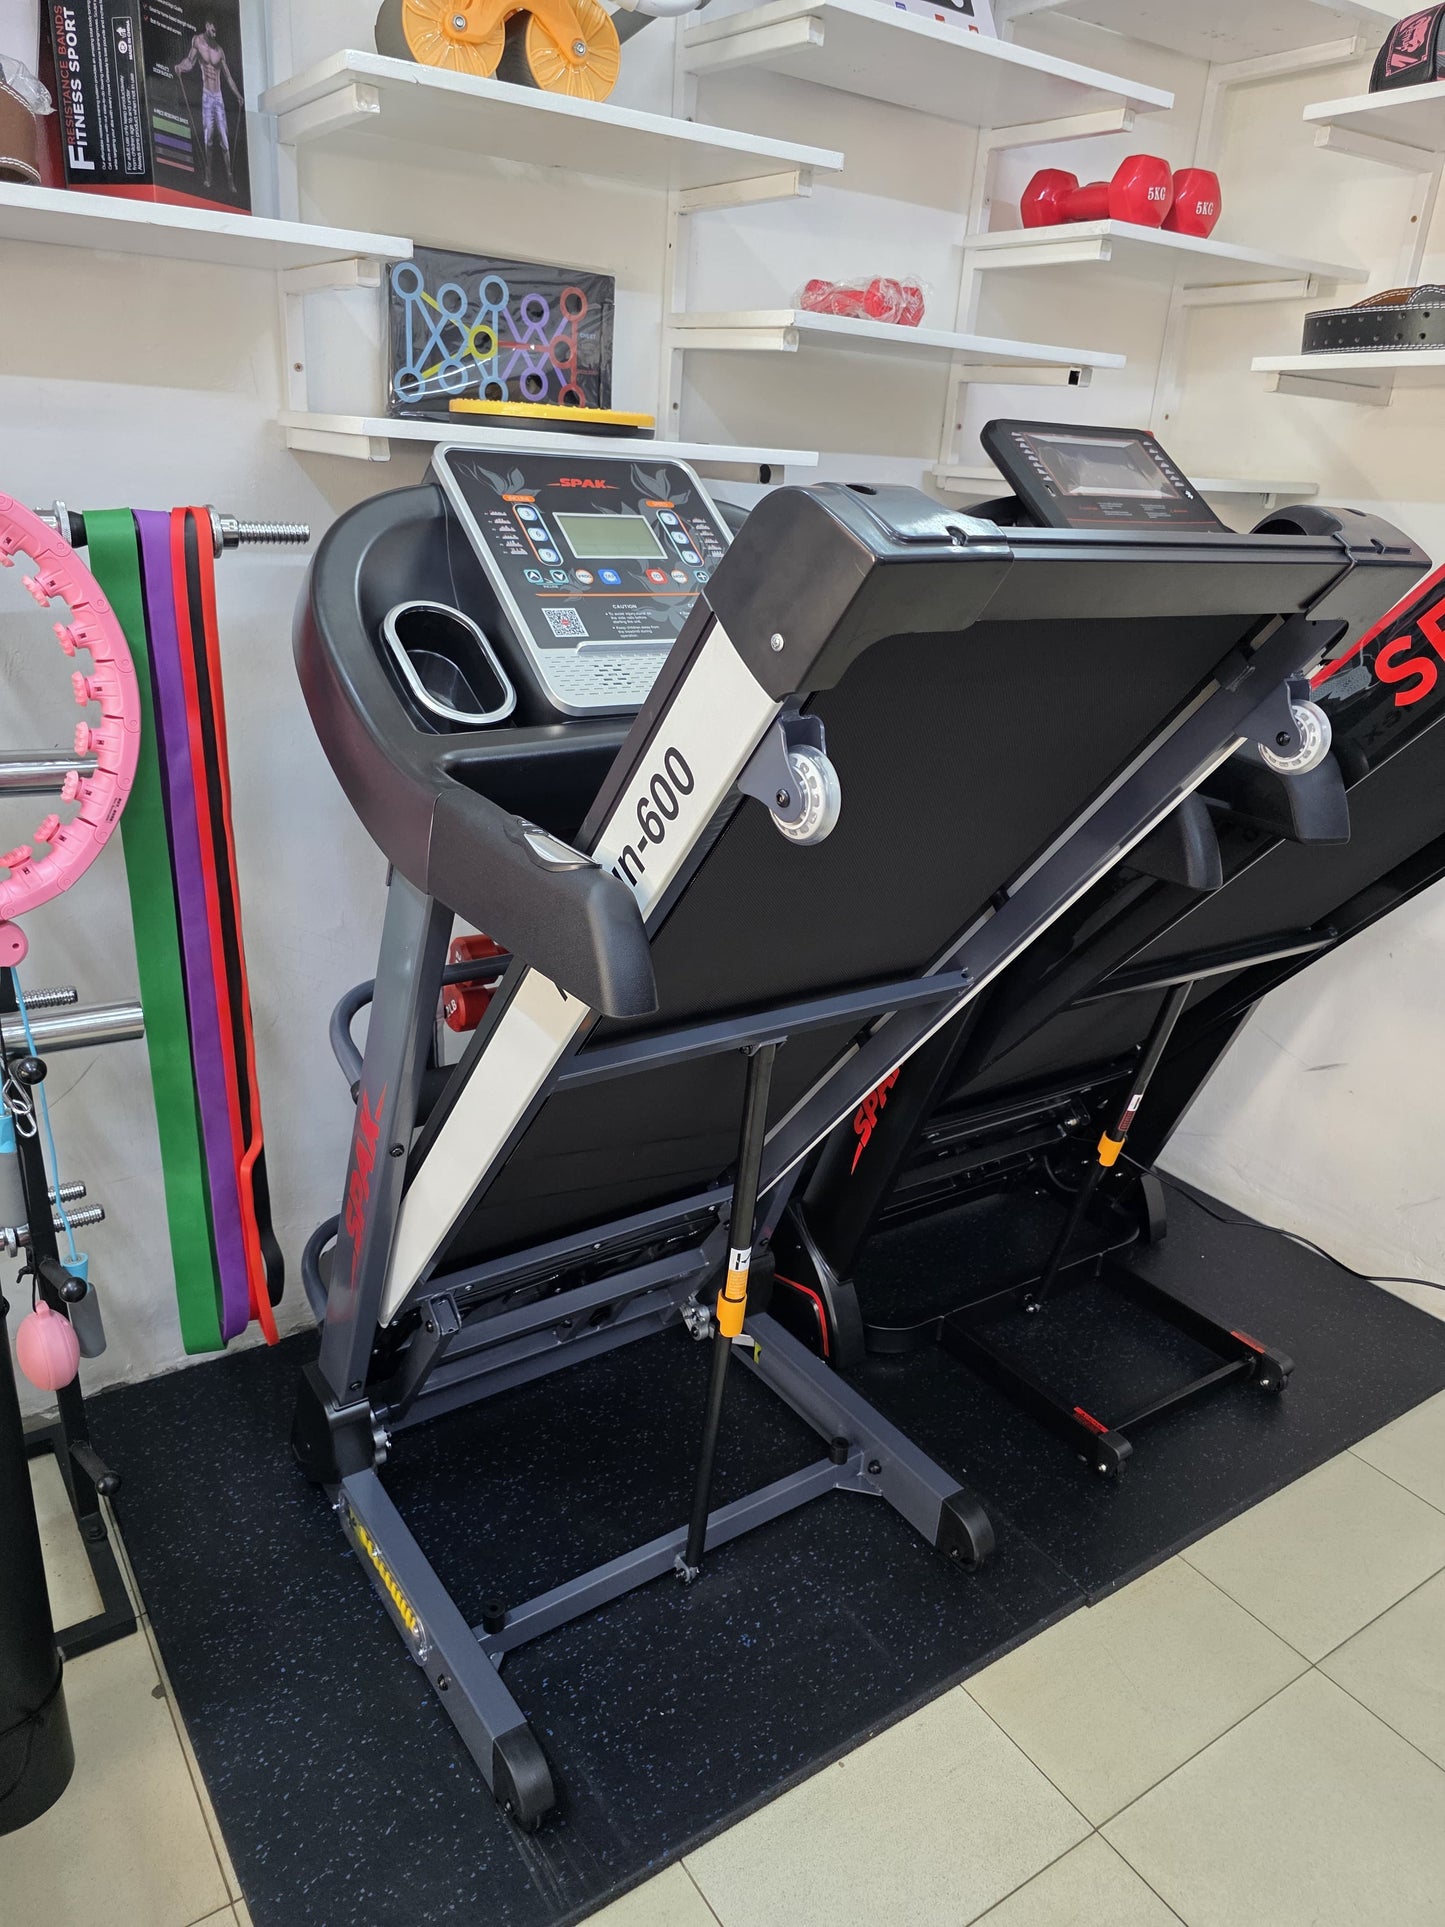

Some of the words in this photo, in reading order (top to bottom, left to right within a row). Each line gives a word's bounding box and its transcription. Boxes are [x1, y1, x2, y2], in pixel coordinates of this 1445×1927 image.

[54, 5, 67, 55] BANDS
[63, 6, 80, 72] SPORT
[60, 60, 76, 144] RESISTANCE
[67, 78, 95, 170] FITNESS
[1147, 186, 1166, 201] 5KG
[1195, 201, 1214, 216] 5KG
[556, 477, 611, 490] SPAK
[346, 1082, 388, 1260] SPAK
